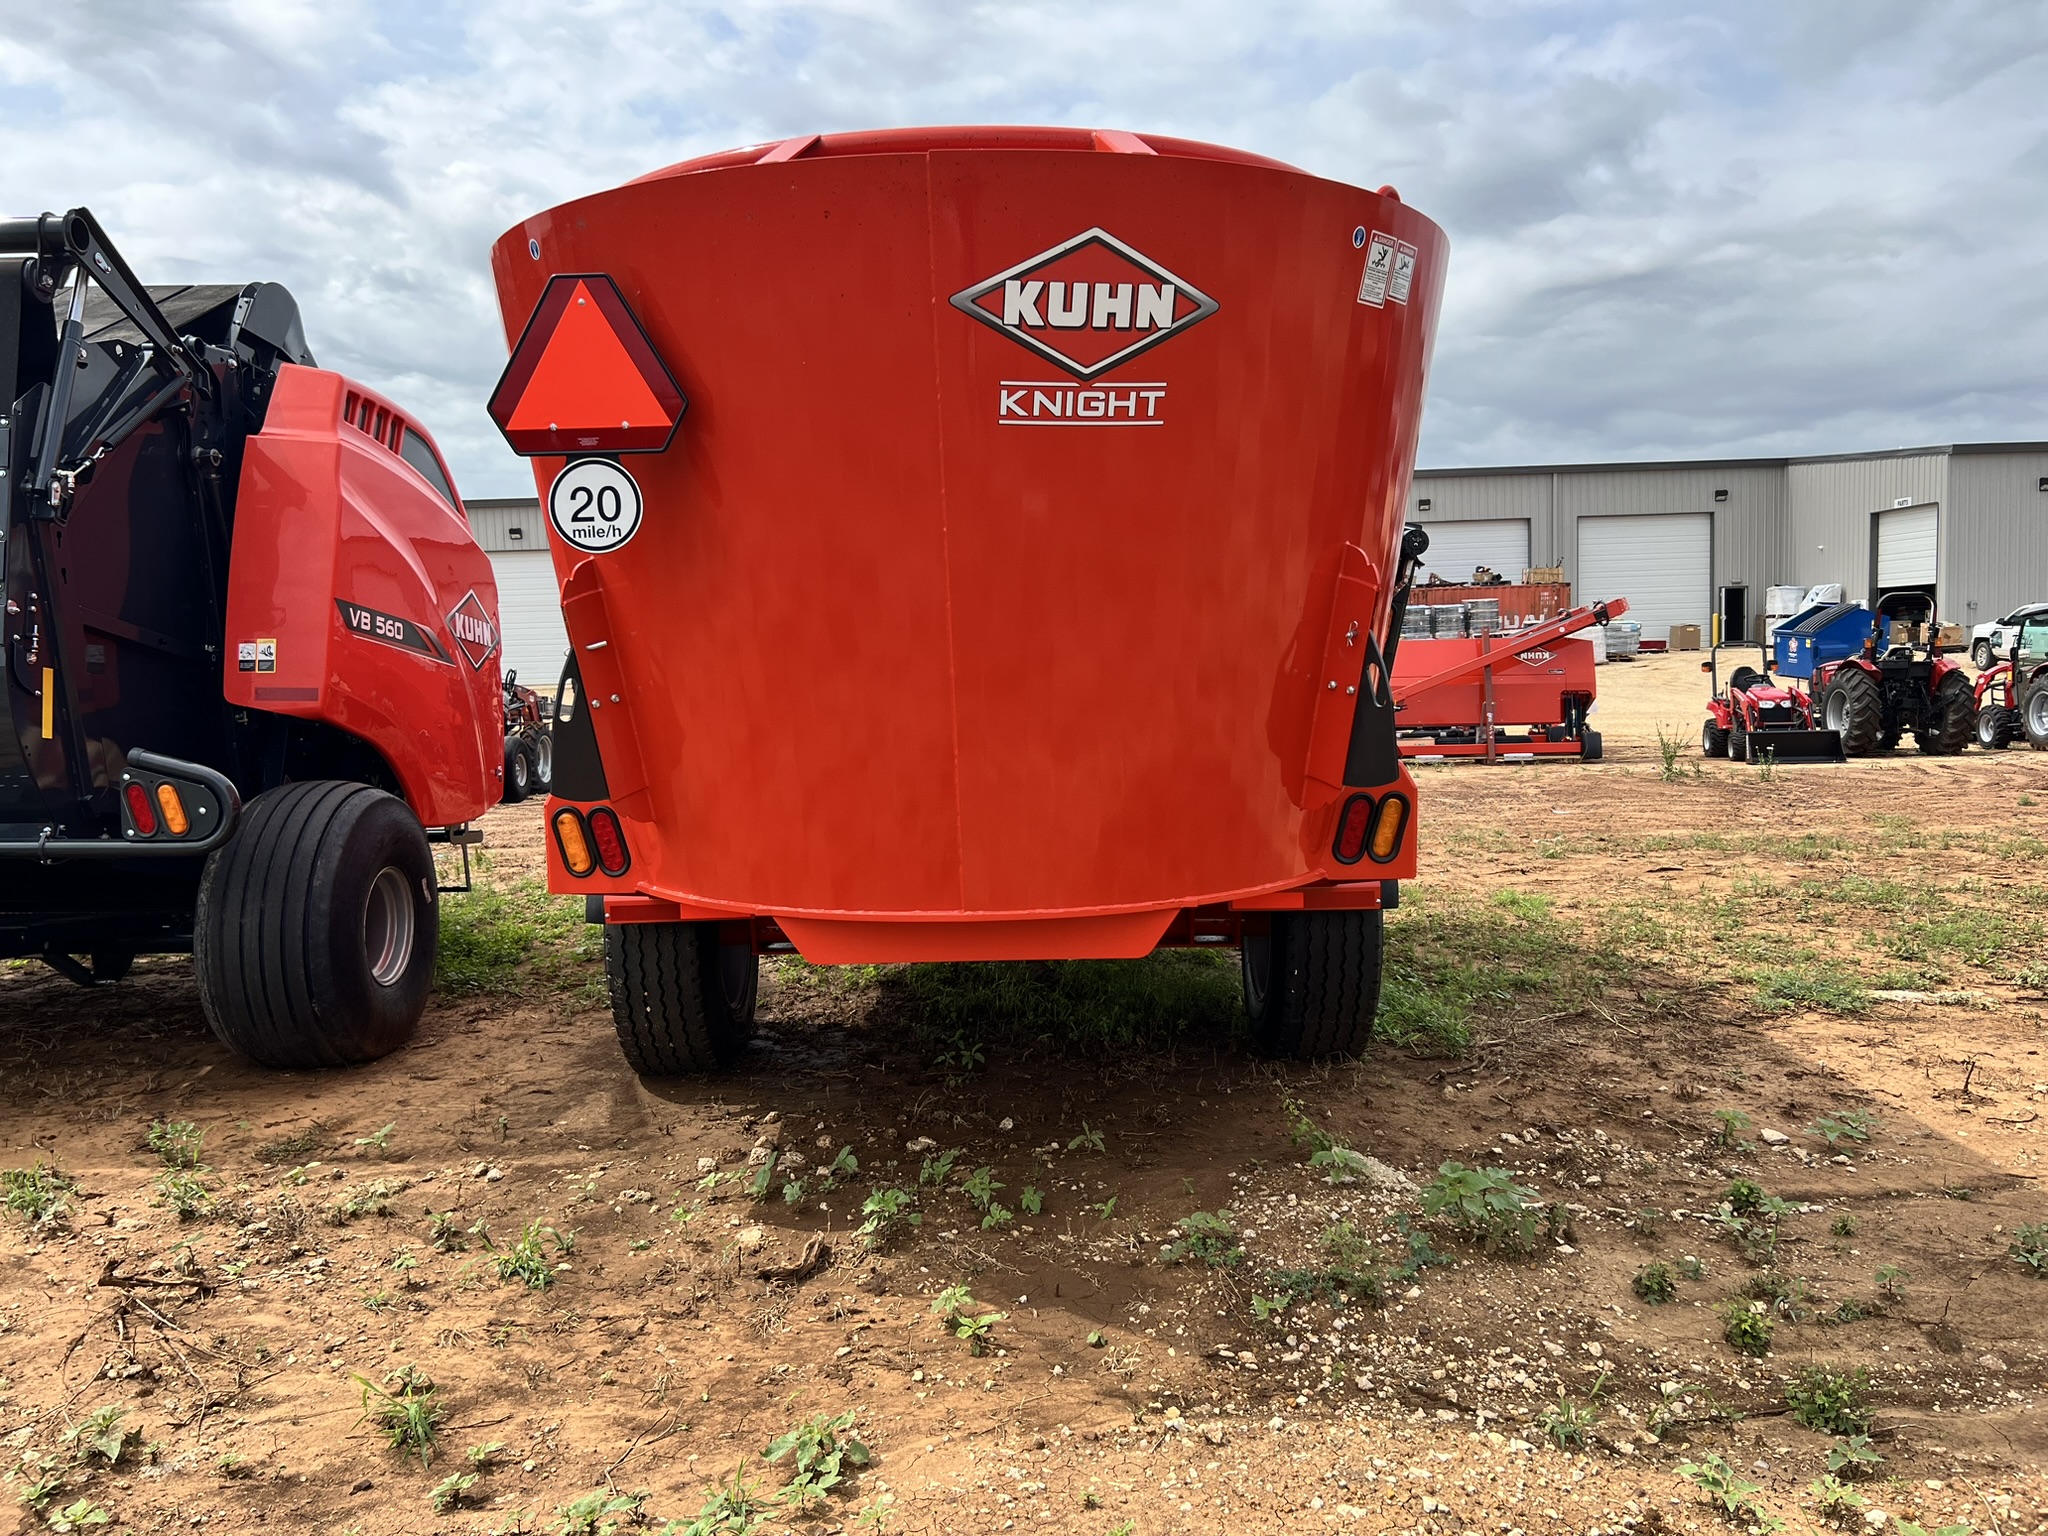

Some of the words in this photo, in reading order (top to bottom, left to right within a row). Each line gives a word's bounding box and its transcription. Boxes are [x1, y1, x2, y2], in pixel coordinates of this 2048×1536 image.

[1003, 280, 1175, 328] KUHN
[1000, 389, 1166, 417] KNIGHT
[570, 485, 622, 523] 20
[572, 524, 622, 539] mile/h
[349, 607, 371, 631] VB
[376, 615, 404, 640] 560
[455, 612, 492, 647] KUHN
[1520, 652, 1550, 660] KUHN
